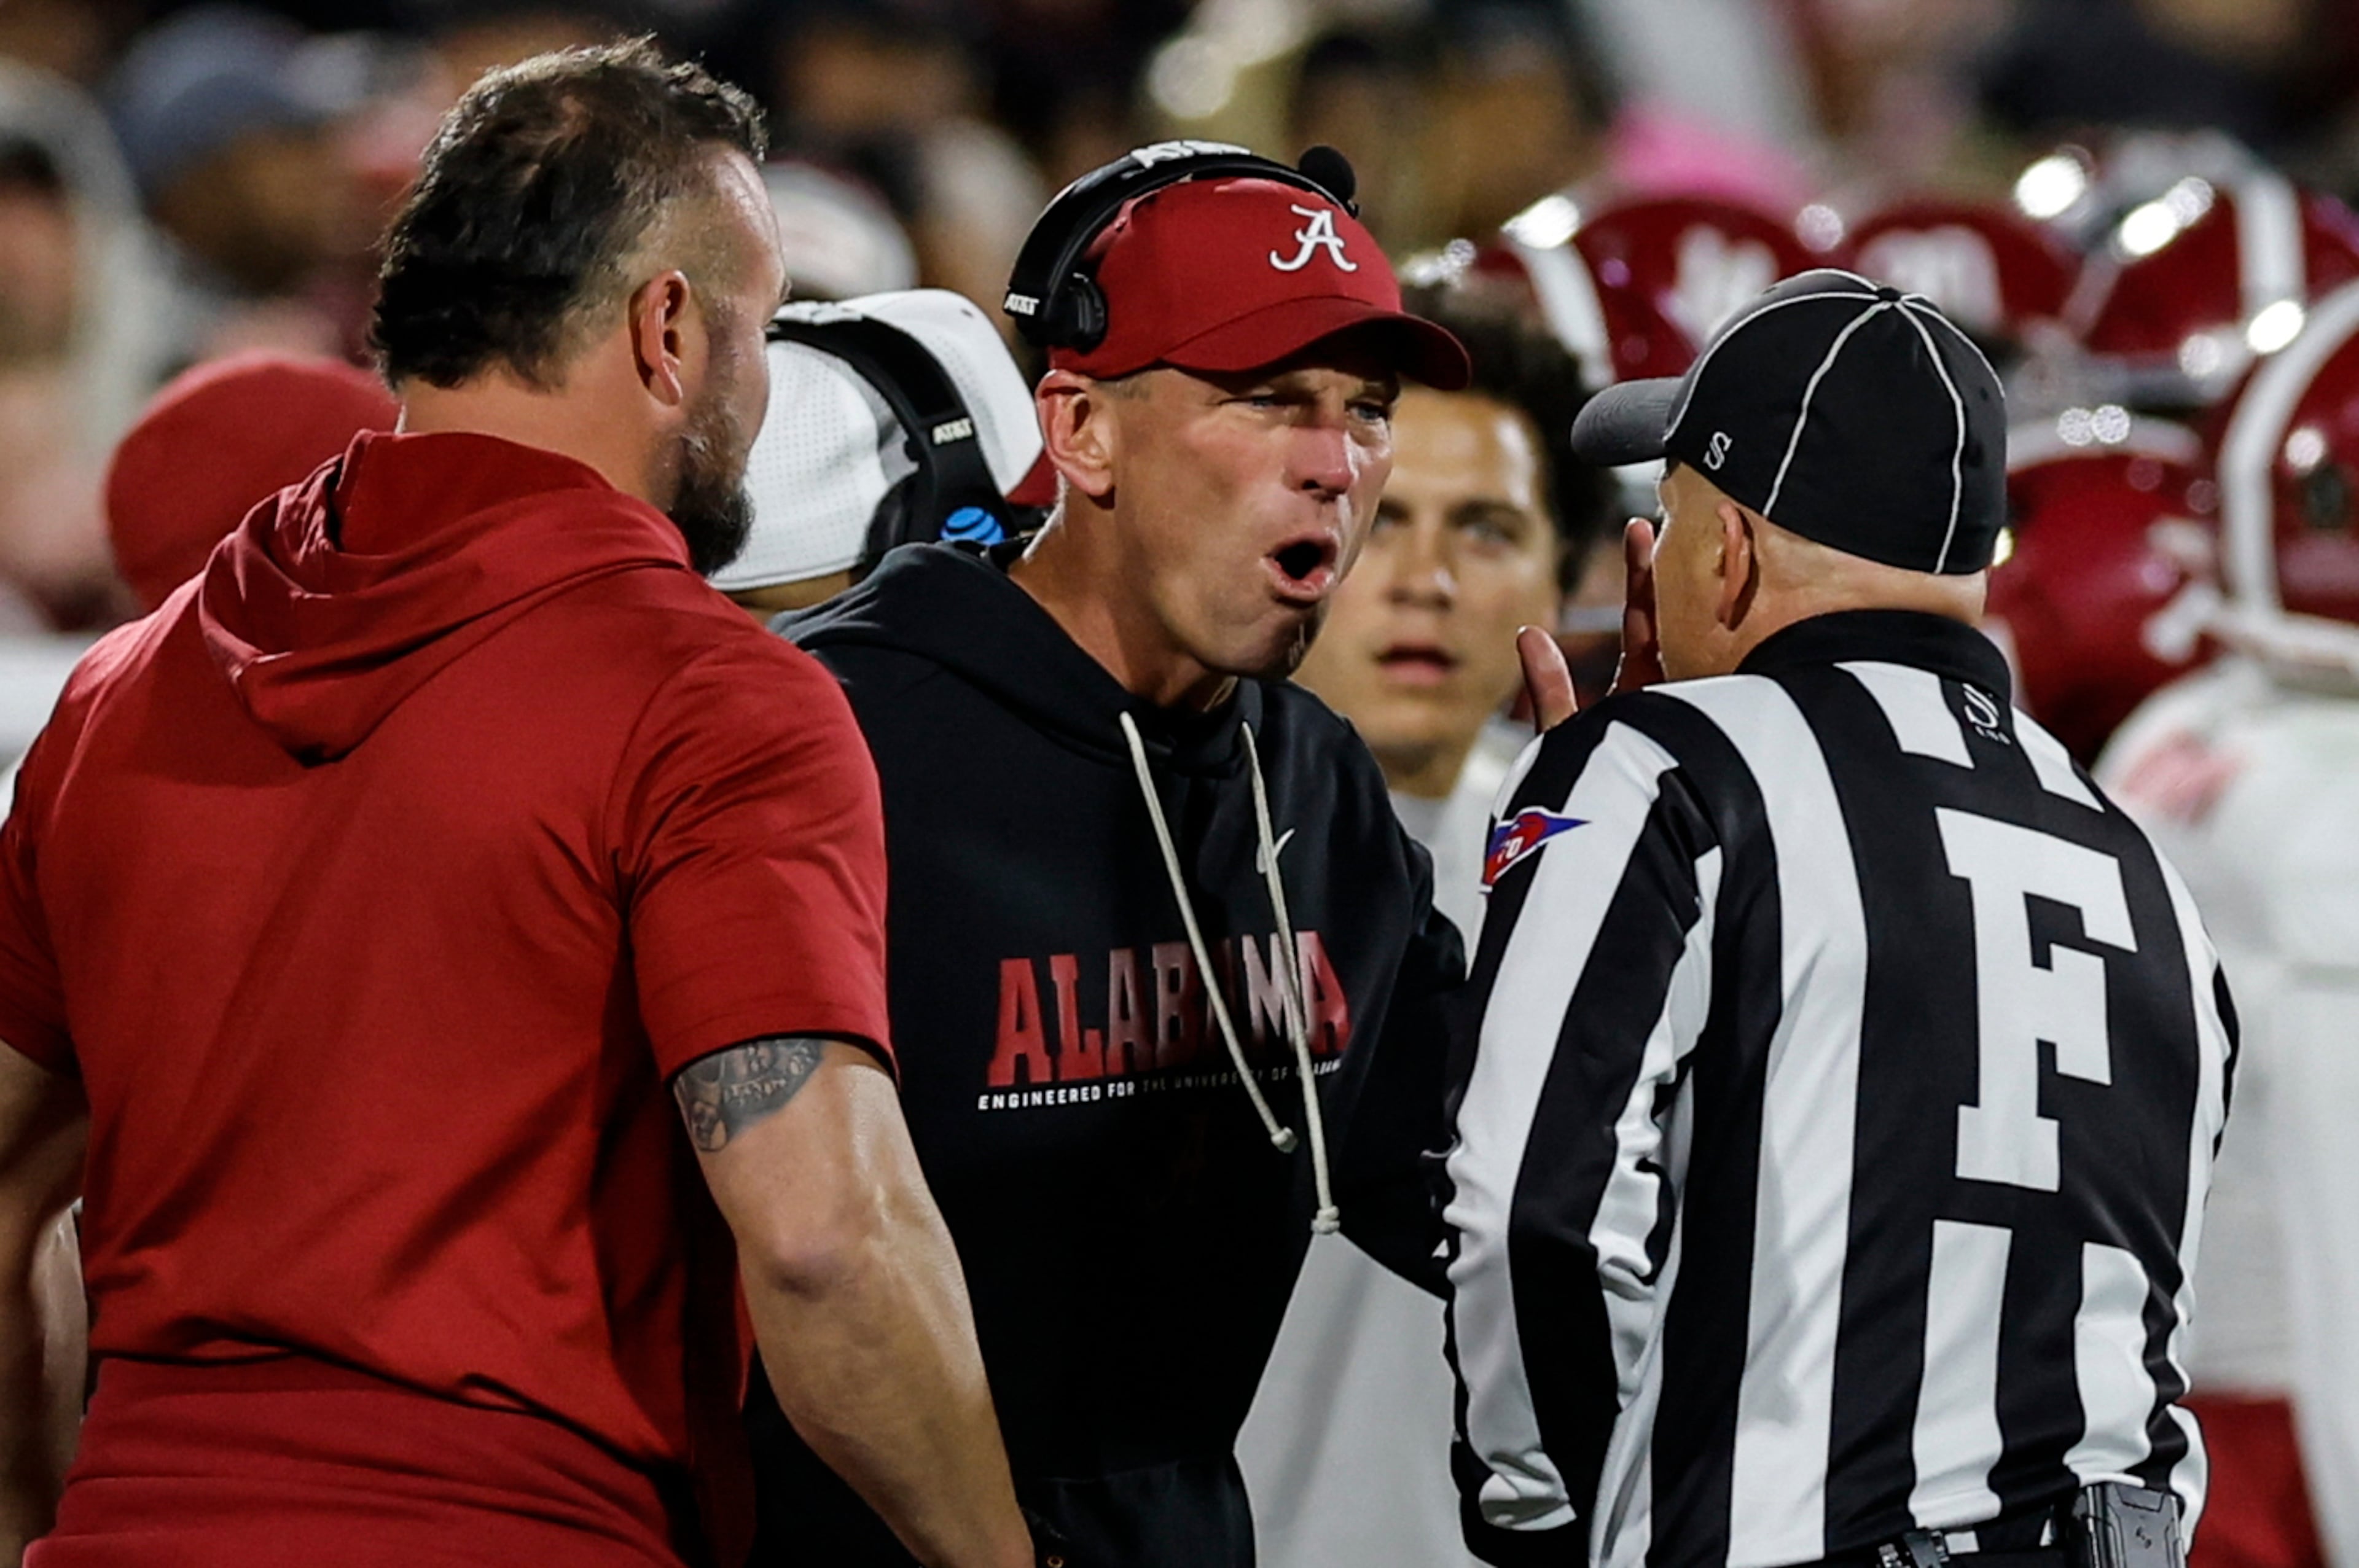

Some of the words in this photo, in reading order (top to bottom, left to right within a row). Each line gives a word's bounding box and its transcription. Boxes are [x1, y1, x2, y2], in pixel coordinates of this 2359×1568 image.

[1269, 203, 1357, 271] A
[1004, 292, 1040, 316] AT&T
[933, 418, 973, 445] AT&T
[1935, 806, 2138, 1193] F
[977, 1083, 1102, 1110] ENGINEERED
[1107, 1080, 1136, 1099] FOR
[1174, 1067, 1264, 1089] UNIVERSY
